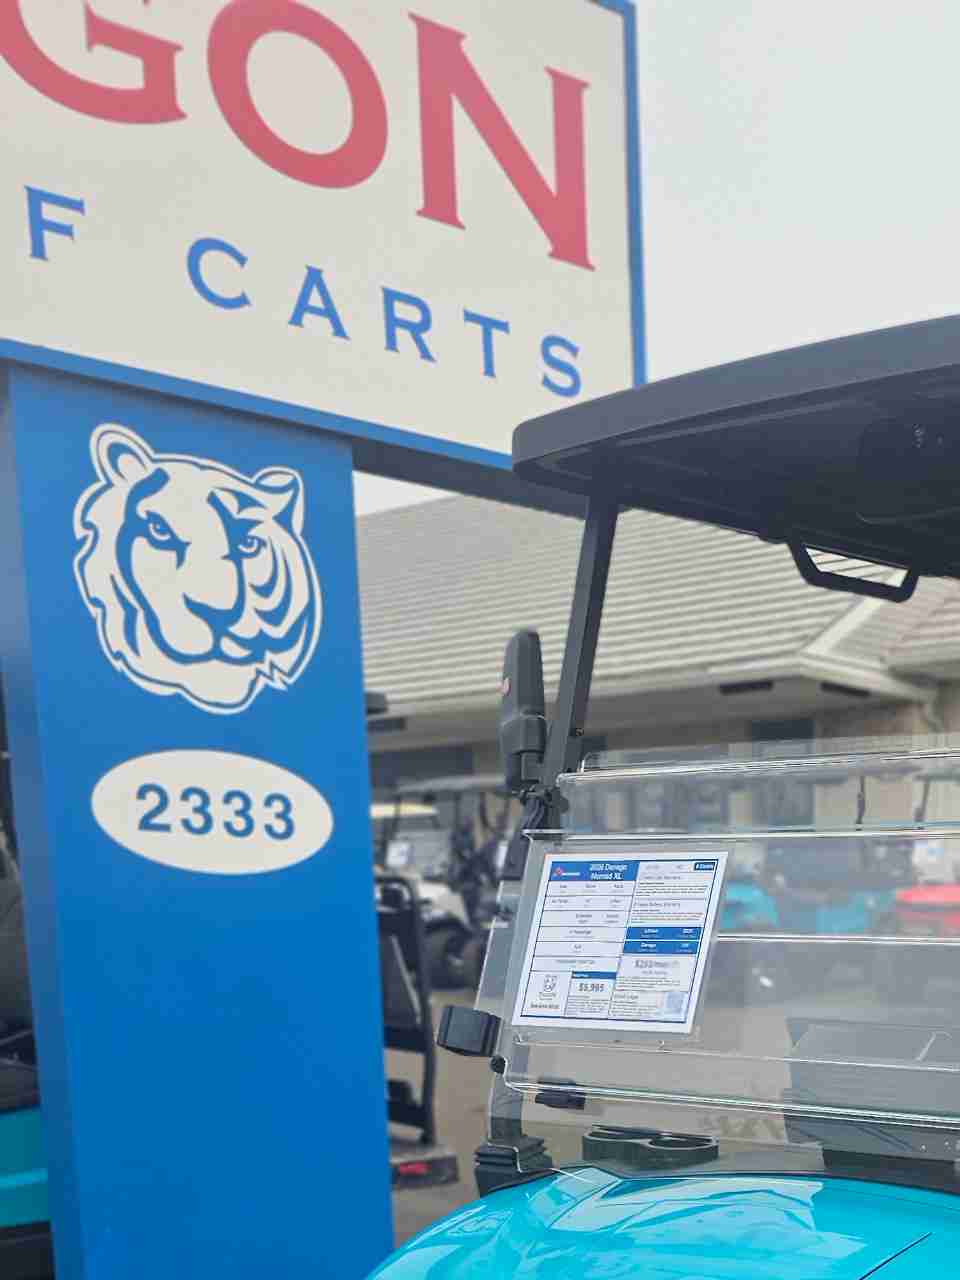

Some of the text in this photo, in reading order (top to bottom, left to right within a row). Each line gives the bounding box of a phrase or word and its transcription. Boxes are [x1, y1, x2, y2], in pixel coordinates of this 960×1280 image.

[24, 185, 582, 398] F CARTS
[135, 783, 295, 840] 2333
